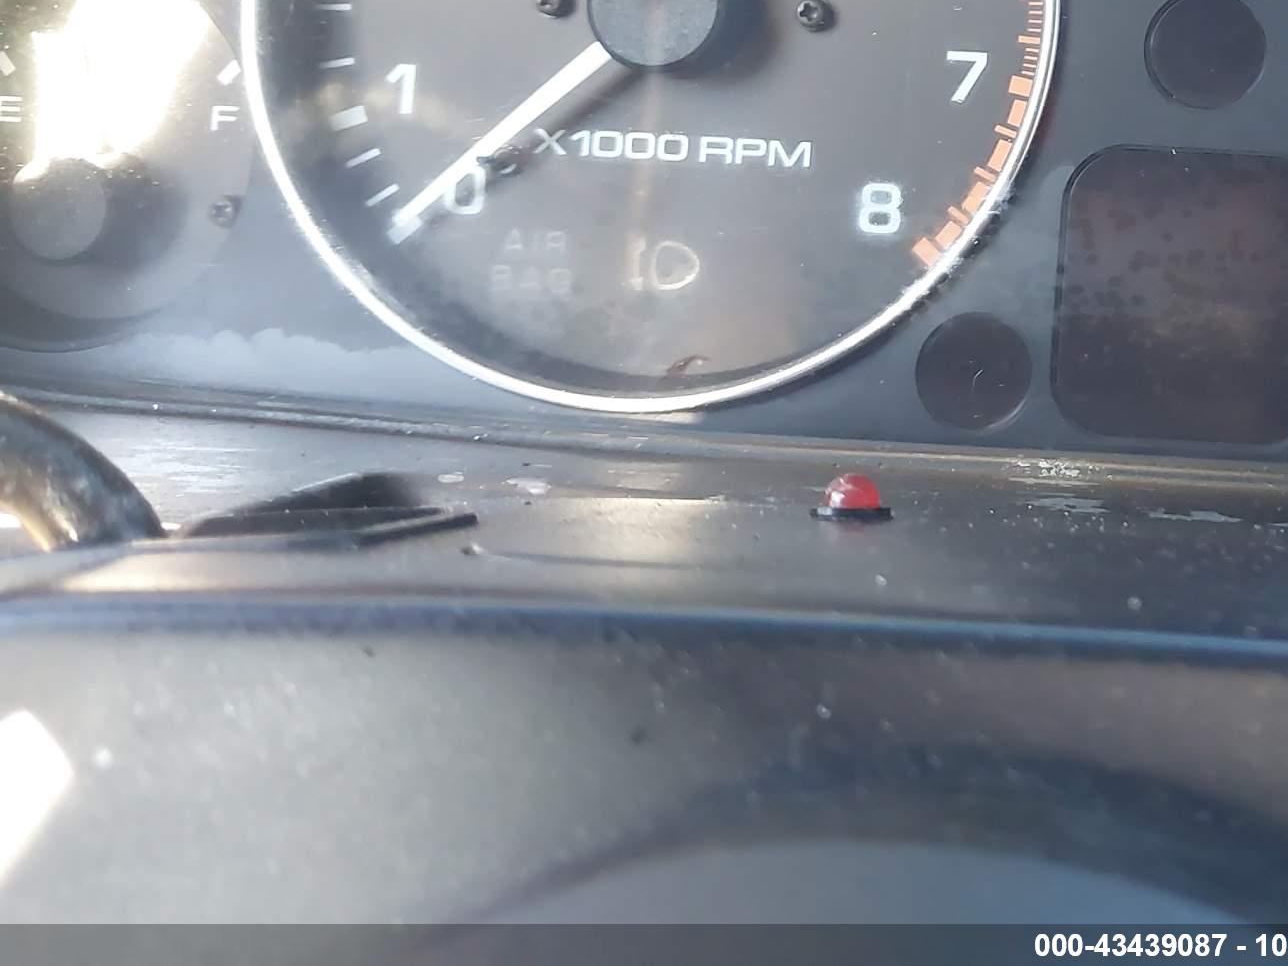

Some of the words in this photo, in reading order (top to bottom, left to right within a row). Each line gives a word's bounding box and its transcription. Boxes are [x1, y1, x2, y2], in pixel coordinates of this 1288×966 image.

[387, 64, 415, 113] 1
[945, 51, 988, 102] 7
[211, 105, 239, 130] F
[698, 136, 812, 168] RPM
[446, 165, 486, 215] 0
[859, 184, 901, 233] 8
